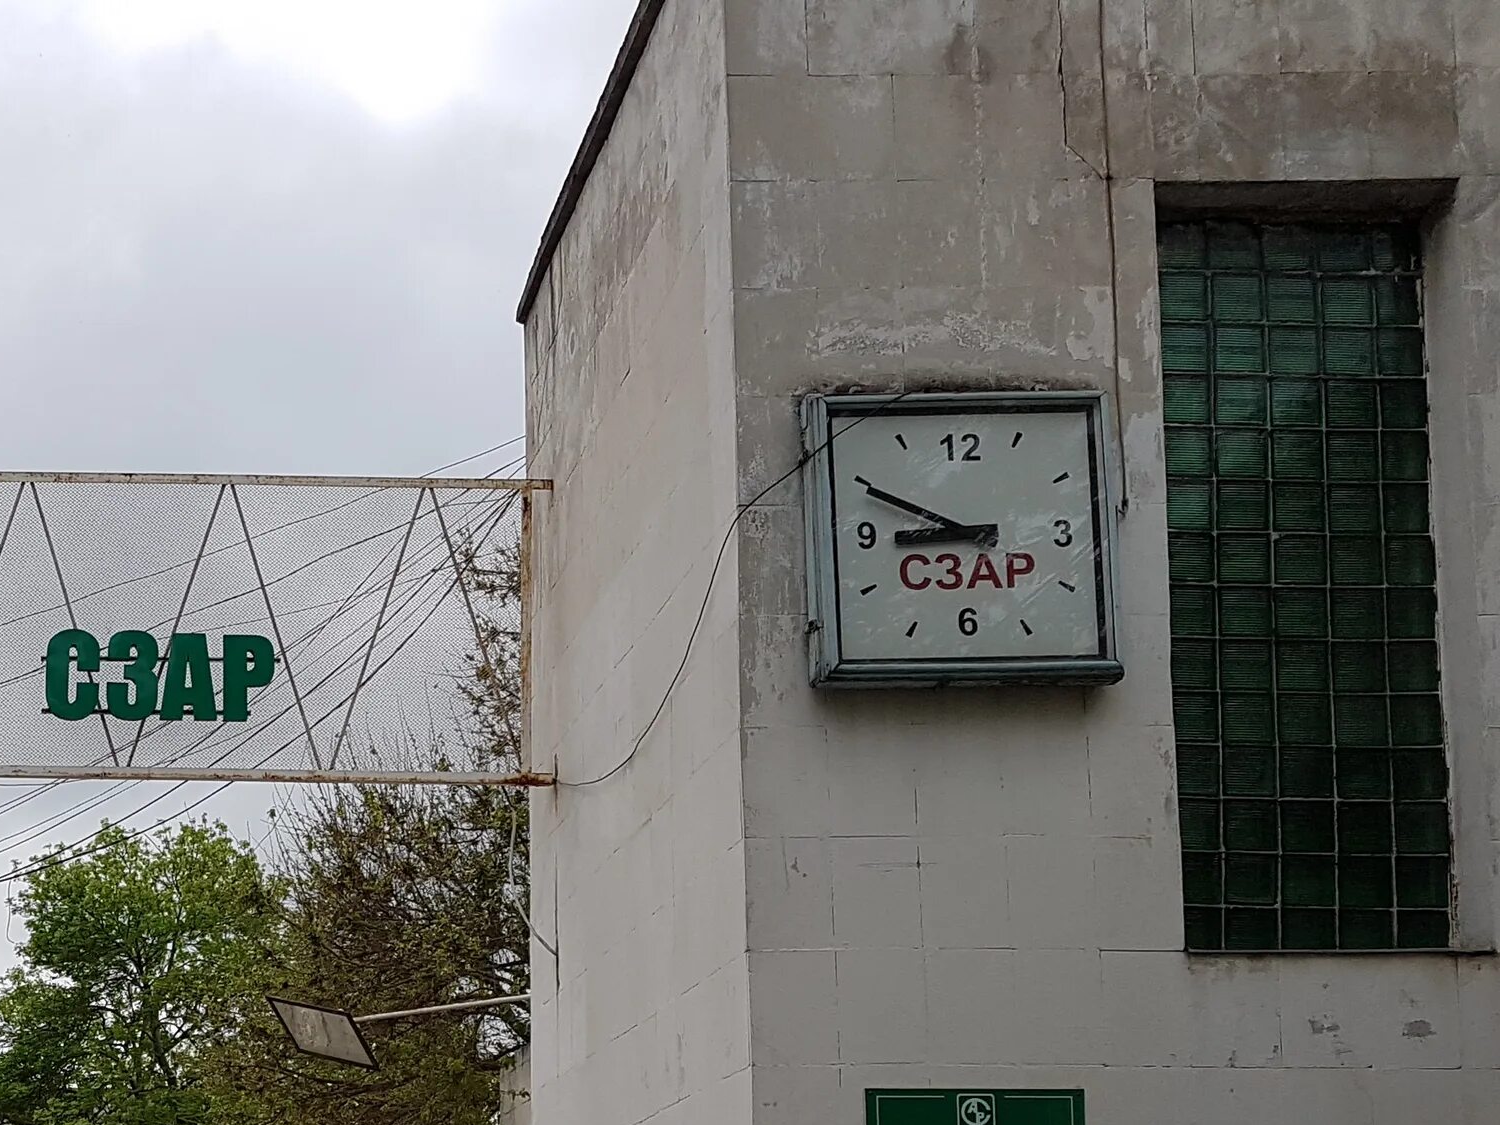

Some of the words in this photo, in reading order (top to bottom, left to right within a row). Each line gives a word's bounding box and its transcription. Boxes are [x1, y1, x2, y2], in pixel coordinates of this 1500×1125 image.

[939, 433, 982, 462] 12
[856, 521, 877, 550] 9
[1053, 520, 1073, 548] 3
[899, 553, 1035, 590] СЗАР
[957, 607, 979, 636] 6
[46, 628, 275, 722] СЗАР
